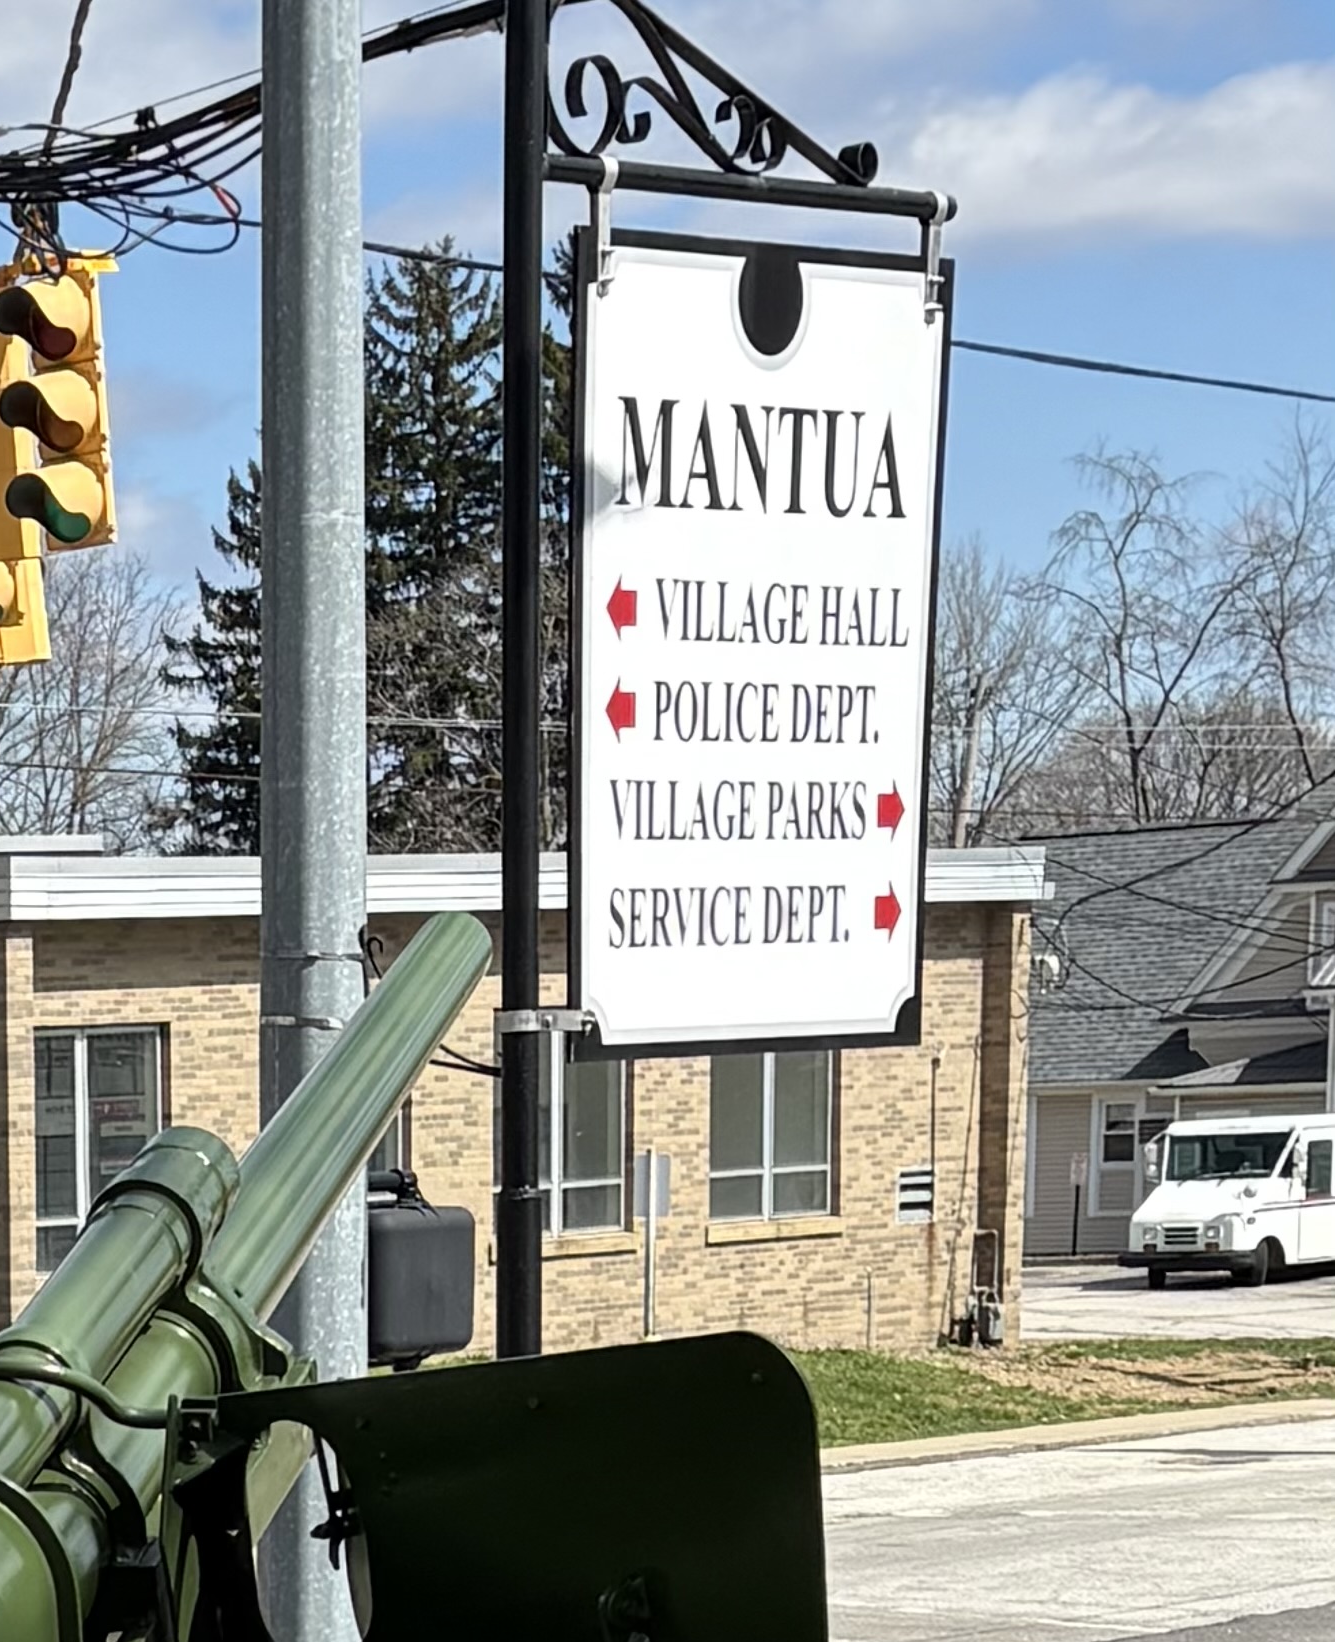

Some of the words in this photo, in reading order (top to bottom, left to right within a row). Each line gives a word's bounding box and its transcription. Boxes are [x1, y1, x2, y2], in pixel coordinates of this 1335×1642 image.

[616, 396, 906, 519] MANTUA
[655, 577, 810, 645] VILLAGE
[820, 585, 908, 647] HALL
[653, 680, 780, 743] POLICE
[790, 683, 880, 744] DEPT.
[610, 779, 755, 841] VILLAGE
[766, 781, 865, 841] PARKS
[608, 885, 752, 950] SERVICE
[761, 885, 850, 944] DEPT.
